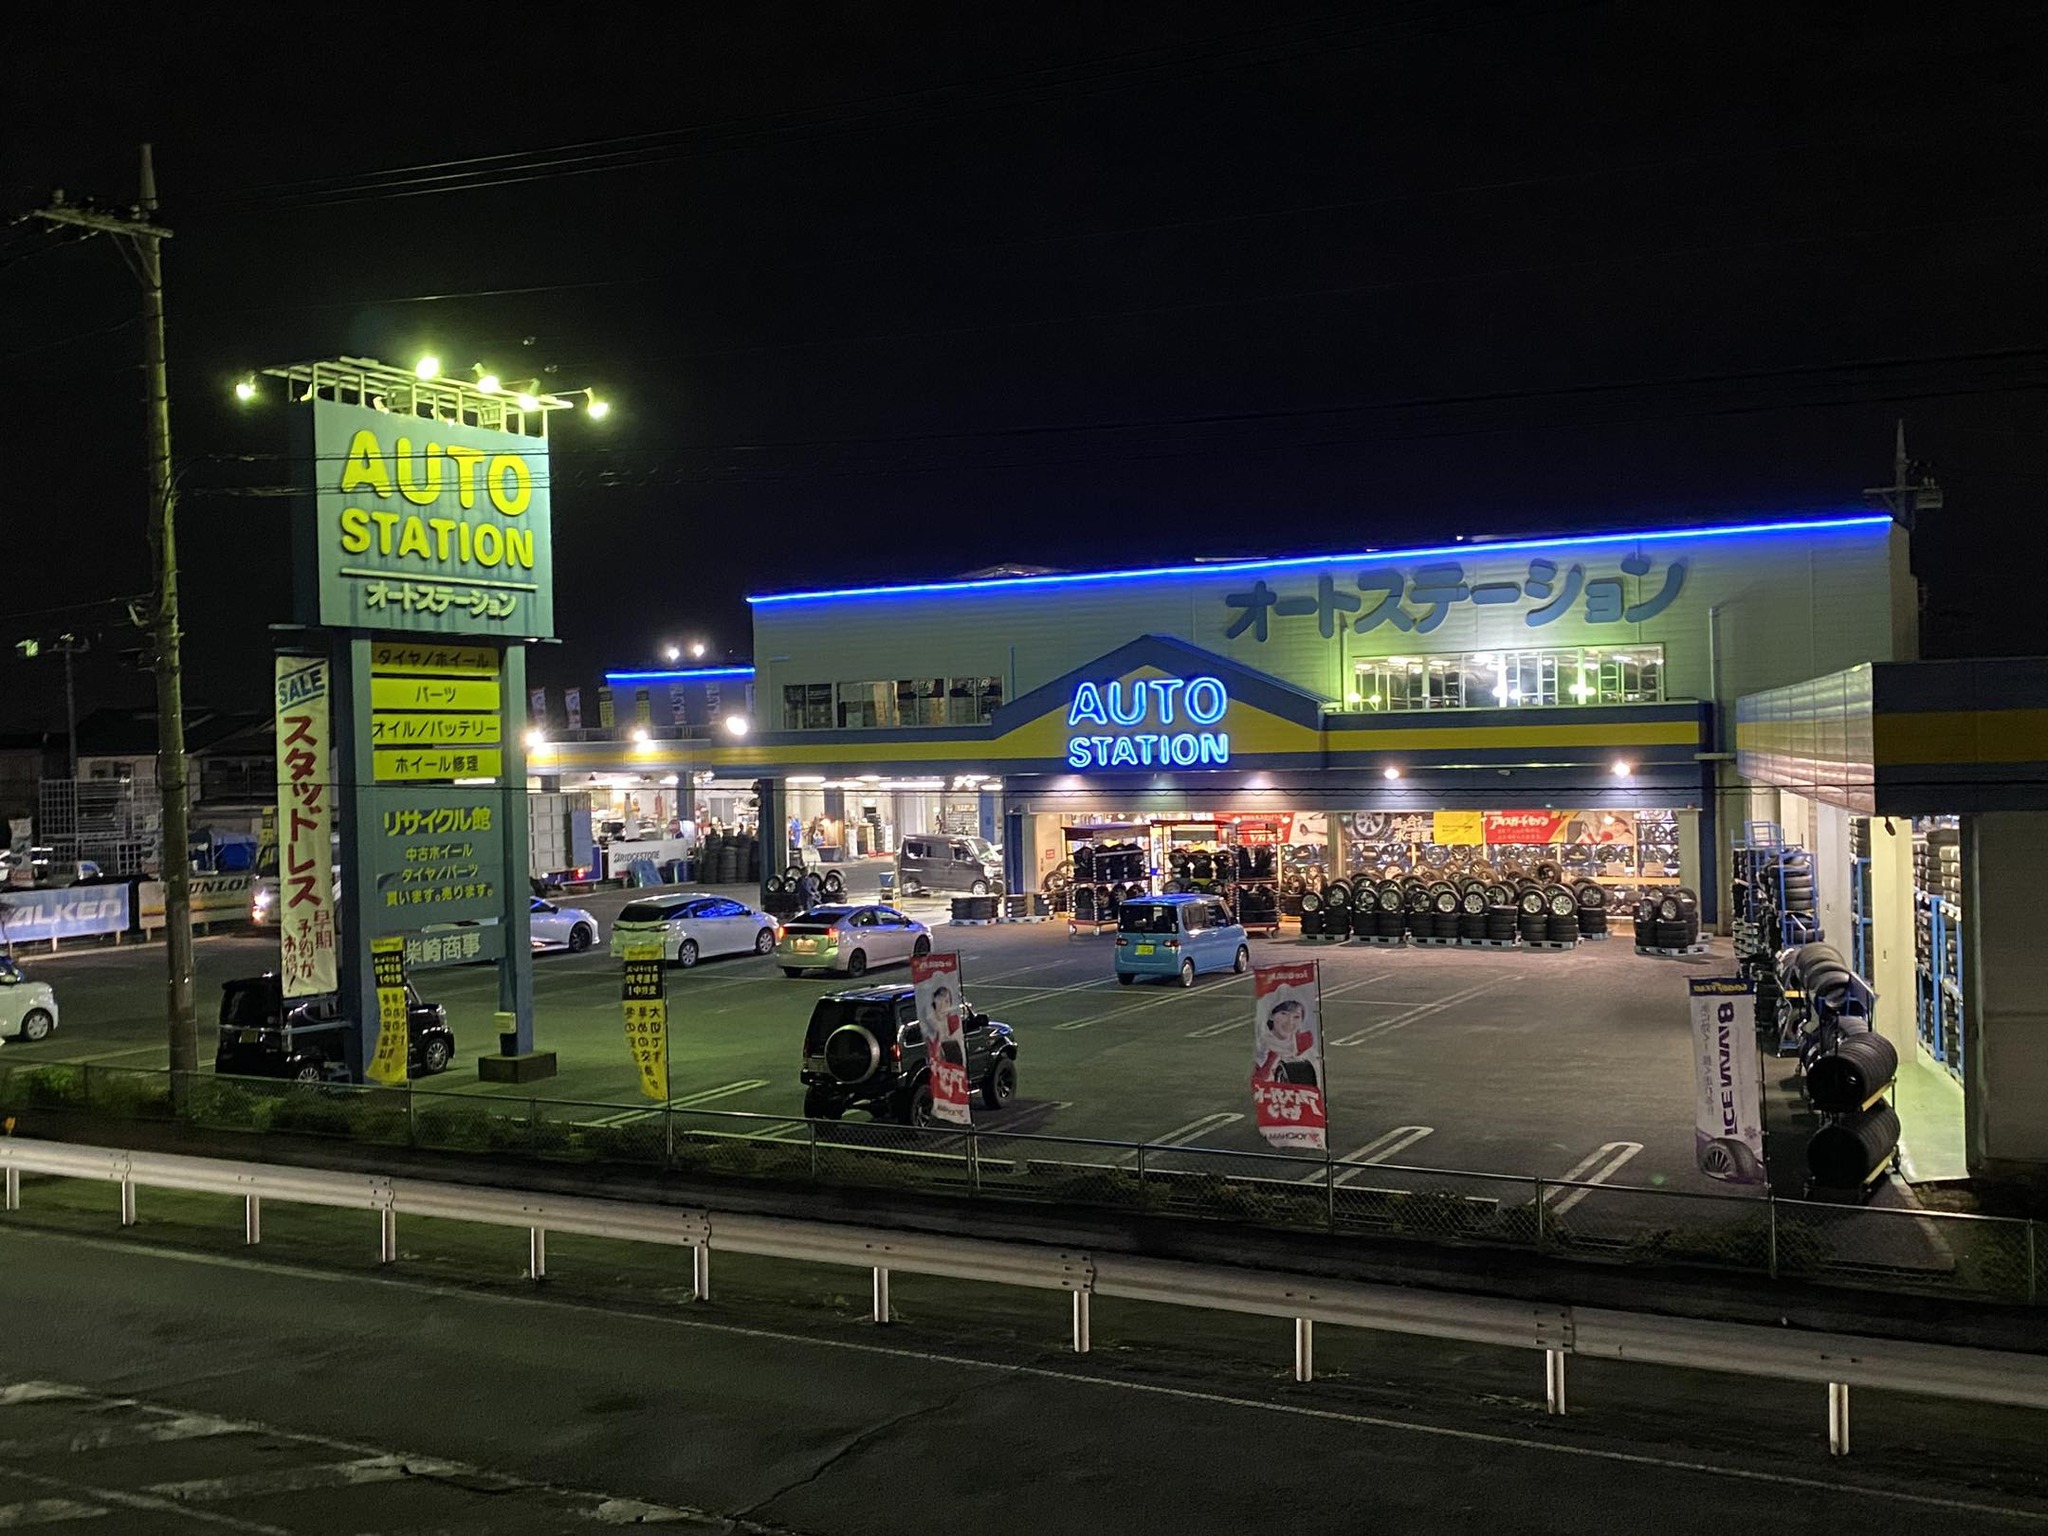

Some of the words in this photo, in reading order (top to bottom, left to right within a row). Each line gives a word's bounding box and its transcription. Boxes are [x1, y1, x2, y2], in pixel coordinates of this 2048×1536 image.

[341, 430, 532, 516] AUTO
[340, 508, 535, 569] STATION
[366, 581, 516, 618] オートステーション
[1226, 555, 1688, 642] オートステーション
[278, 668, 325, 705] SALE
[416, 686, 456, 703] パーツ
[1068, 677, 1228, 727] AUTO
[395, 755, 479, 773] ホイール修理
[1069, 731, 1229, 768] STATION
[283, 715, 323, 909] スタッドレス
[383, 806, 492, 837] リサイクル館
[406, 843, 473, 862] 中古ホイール
[3, 900, 121, 928] ALKEN
[314, 909, 333, 949] 早期
[297, 918, 315, 978] 予約が
